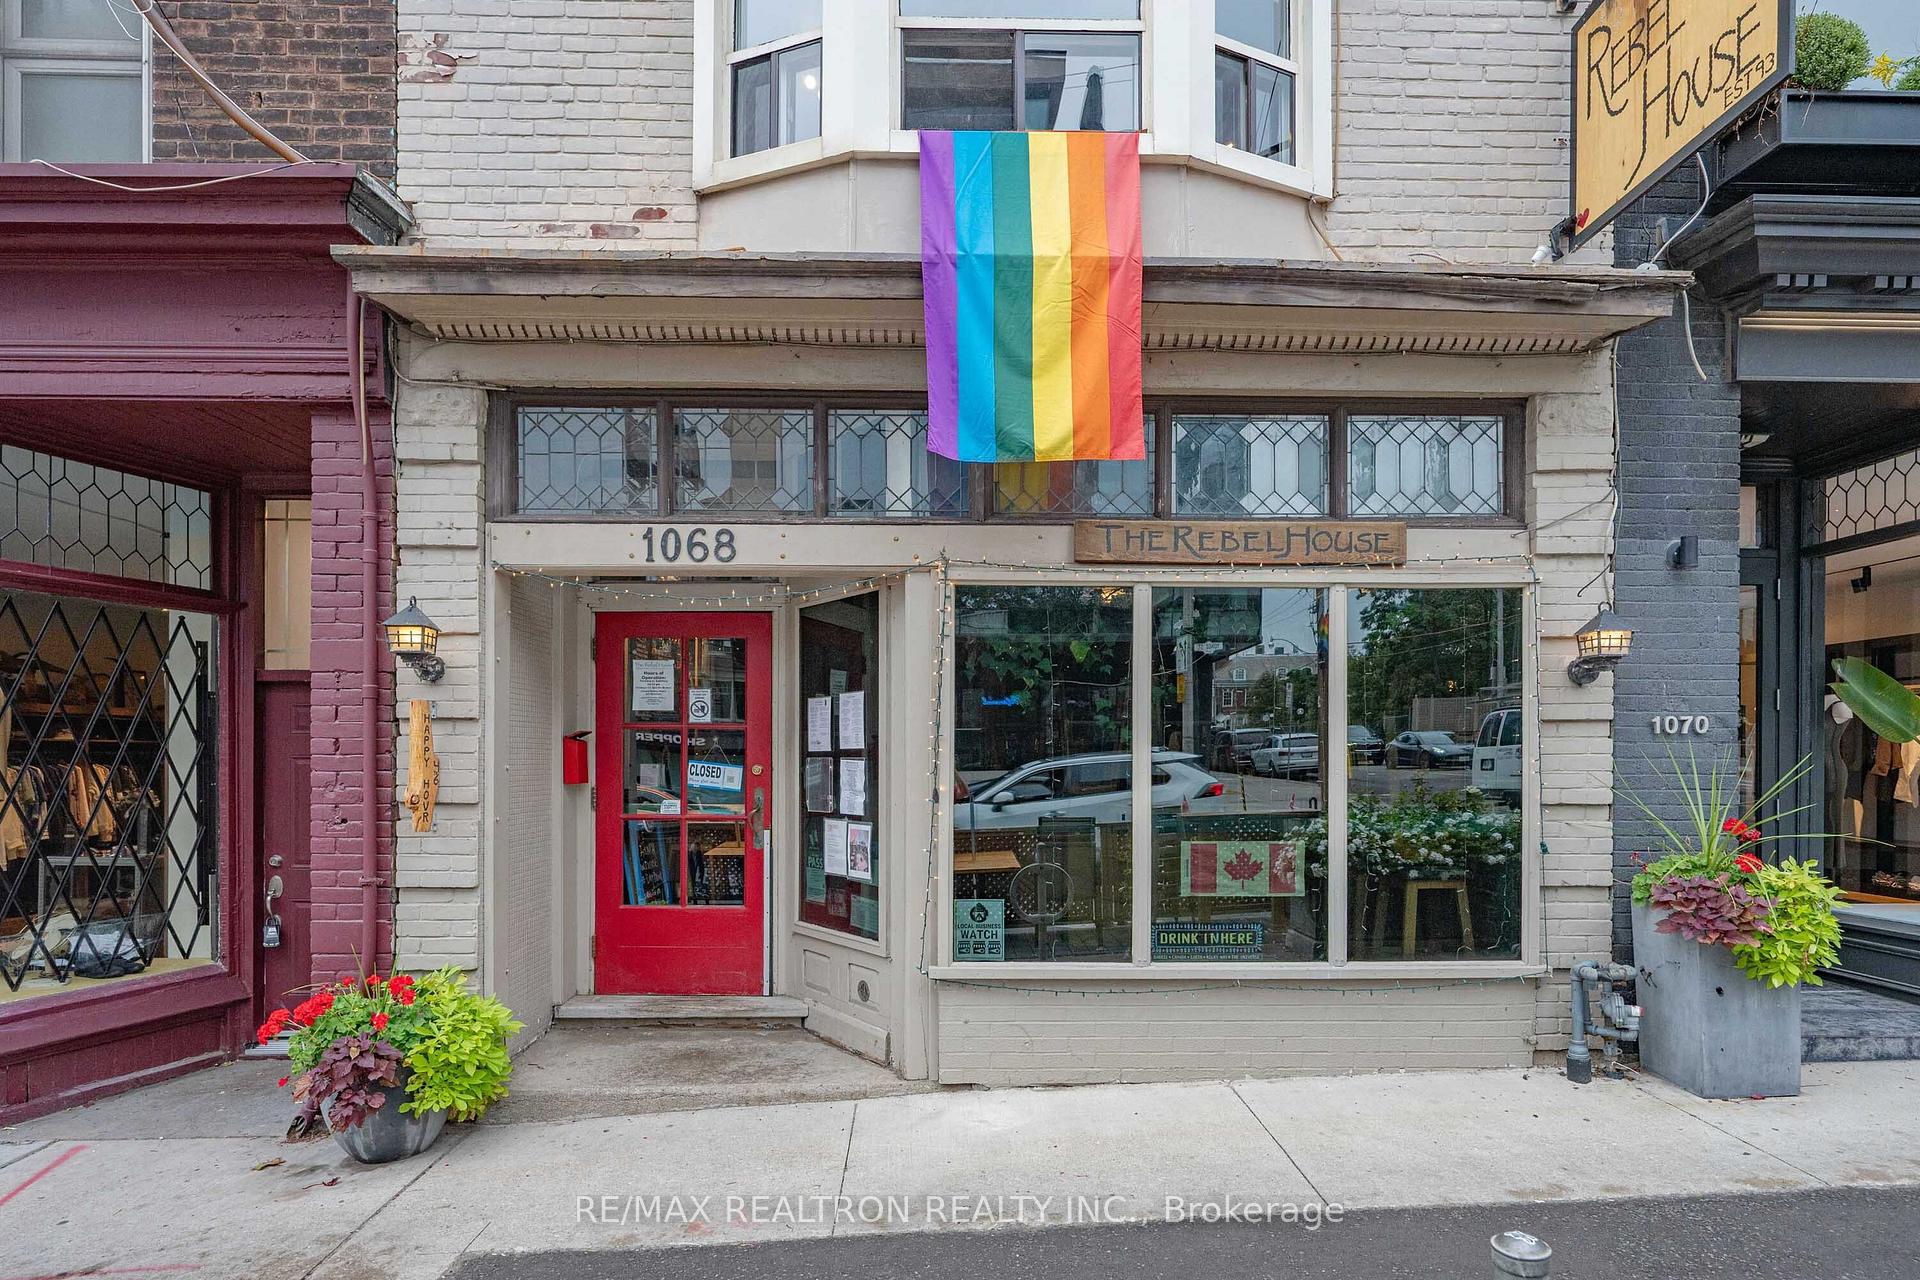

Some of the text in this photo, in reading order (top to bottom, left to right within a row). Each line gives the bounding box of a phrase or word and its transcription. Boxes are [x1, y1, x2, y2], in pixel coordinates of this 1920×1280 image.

[1587, 0, 1686, 120] REBEL
[1723, 52, 1776, 110] EST 93
[1624, 4, 1761, 190] HOUSE
[643, 527, 737, 562] 1068
[1095, 525, 1394, 559] THE REBEL HOUSE
[1651, 715, 1709, 734] 1070
[689, 764, 722, 779] CLOSED
[808, 856, 824, 869] PASS
[960, 930, 998, 939] WATCH
[1160, 932, 1253, 944] DRINK IN HERE
